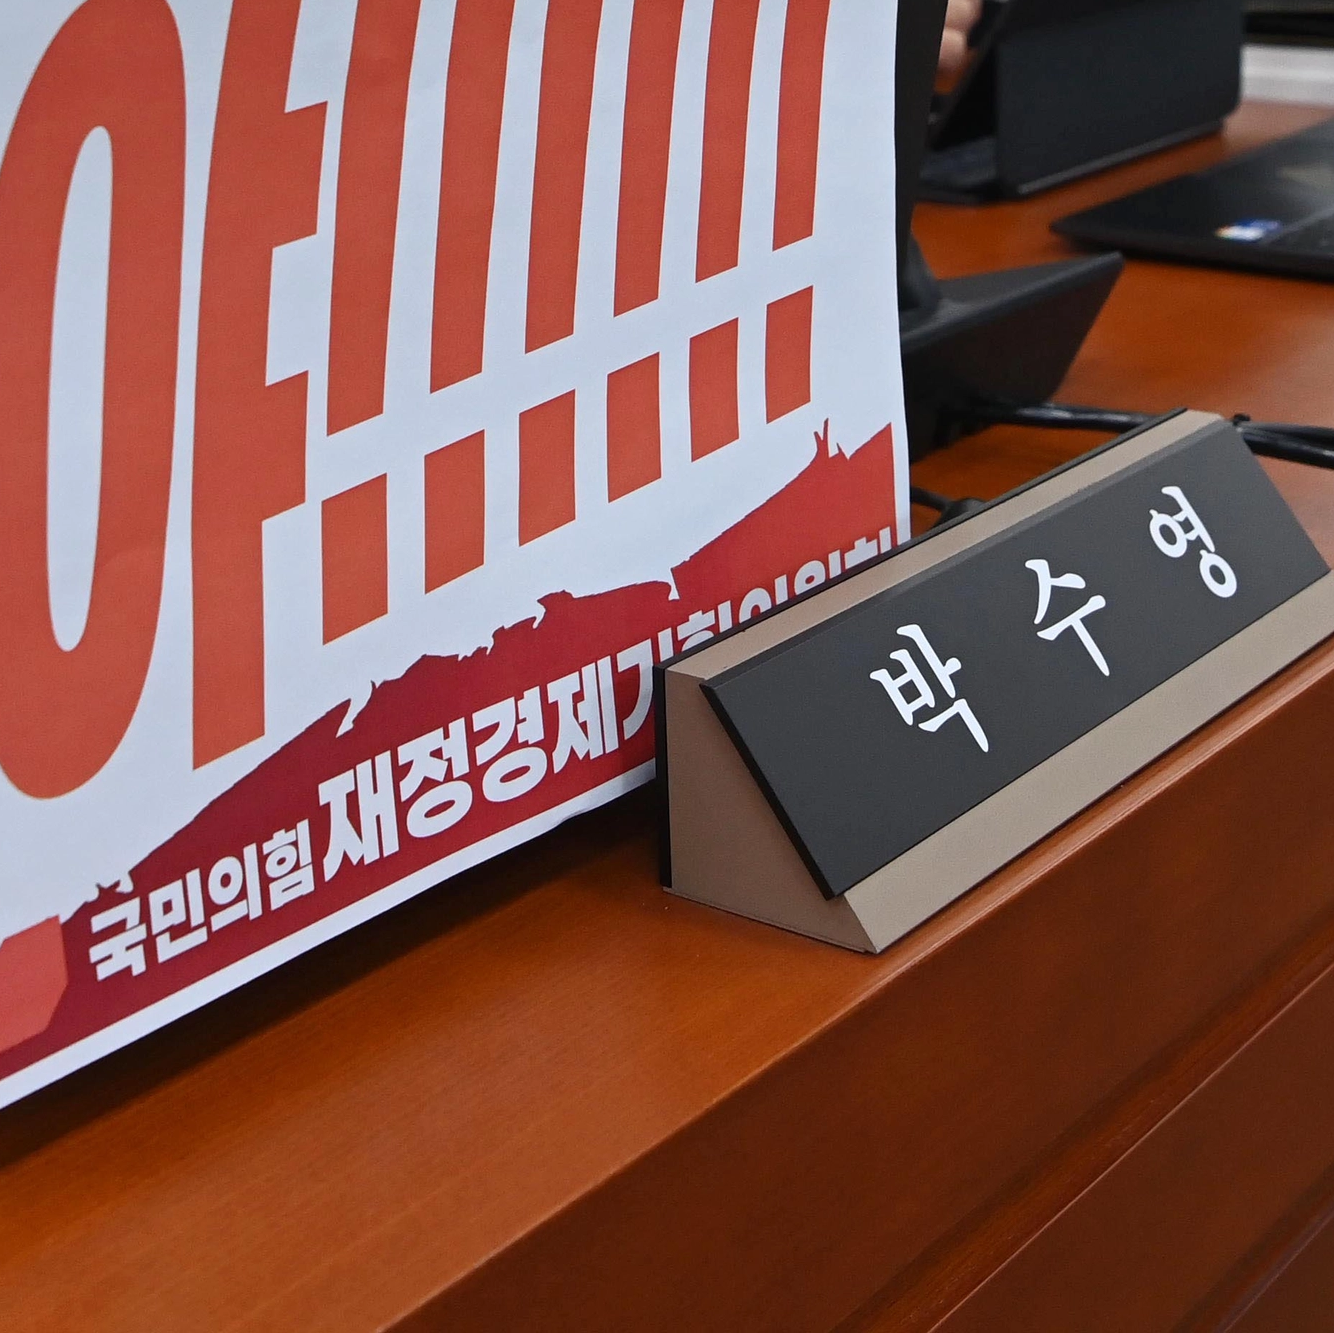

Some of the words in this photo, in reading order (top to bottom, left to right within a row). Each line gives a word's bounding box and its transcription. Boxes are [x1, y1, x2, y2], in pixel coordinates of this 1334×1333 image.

[89, 818, 315, 980] 국민의힘
[319, 526, 891, 879] 재정경제기
[870, 624, 989, 752] 박
[1025, 559, 1109, 676] 수
[1150, 486, 1237, 597] 영
